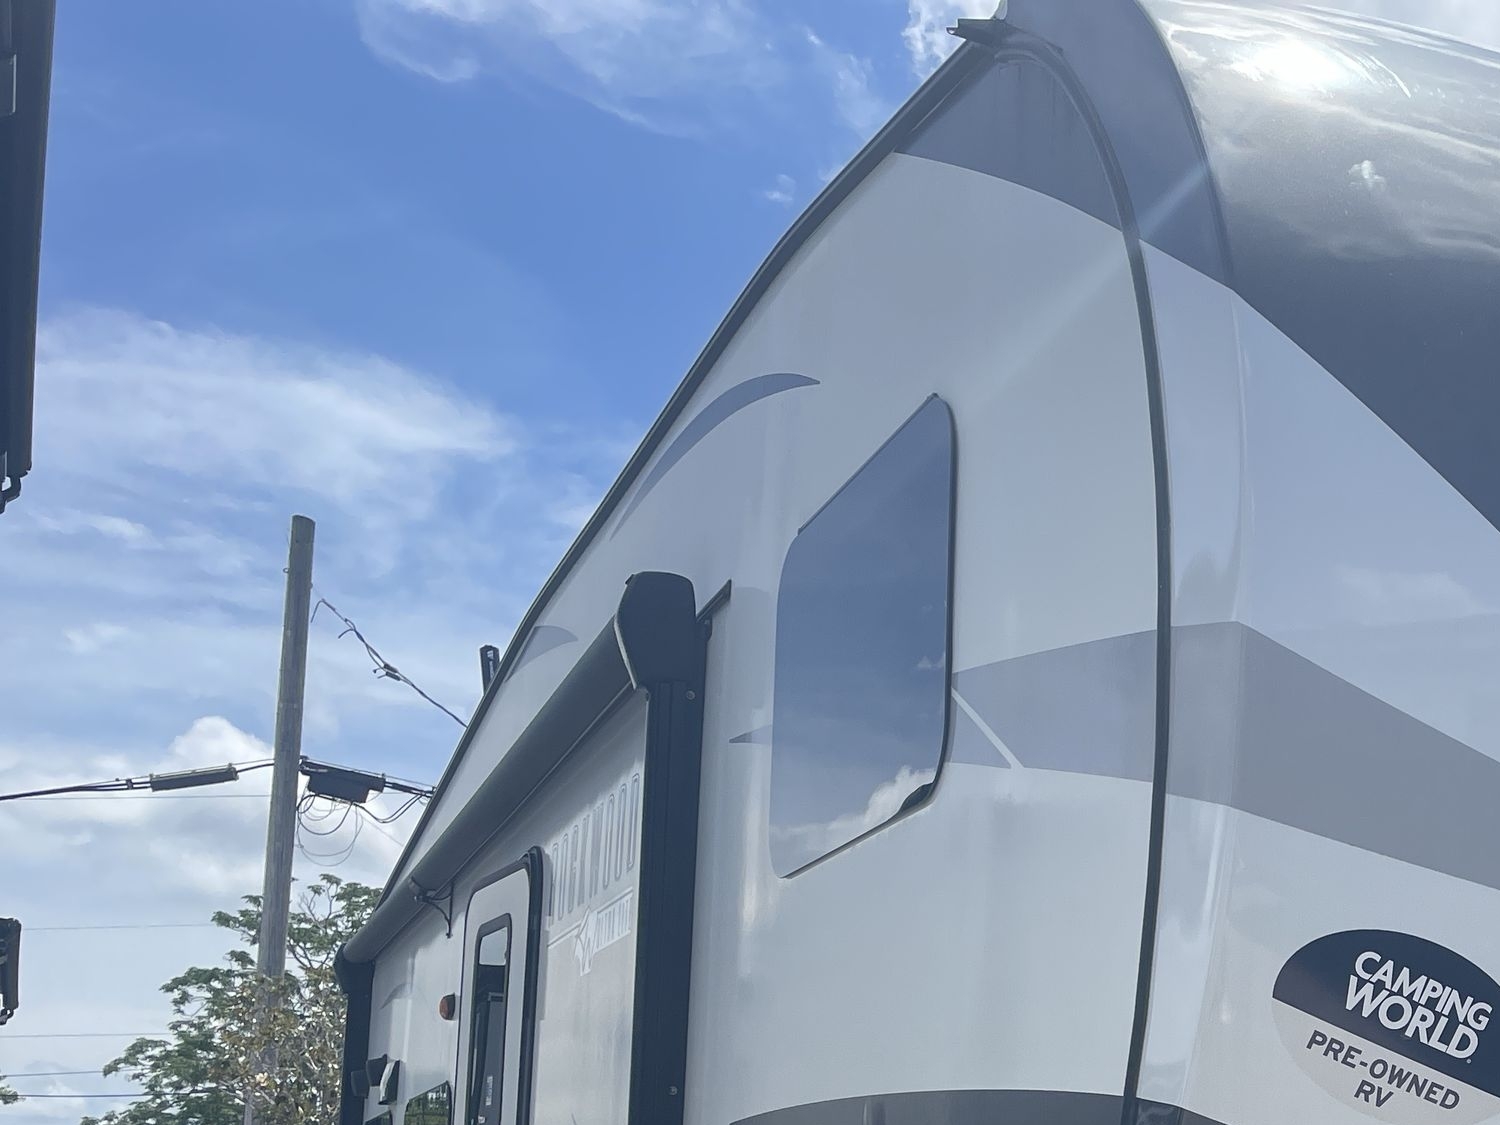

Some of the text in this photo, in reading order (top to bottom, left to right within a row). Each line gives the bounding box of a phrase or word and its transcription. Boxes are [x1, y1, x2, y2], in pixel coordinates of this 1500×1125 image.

[1345, 974, 1479, 1060] WORLD
[1354, 951, 1493, 1031] CAMPING
[1305, 1029, 1461, 1110] PRE-OWNED
[1353, 1079, 1394, 1108] RV
